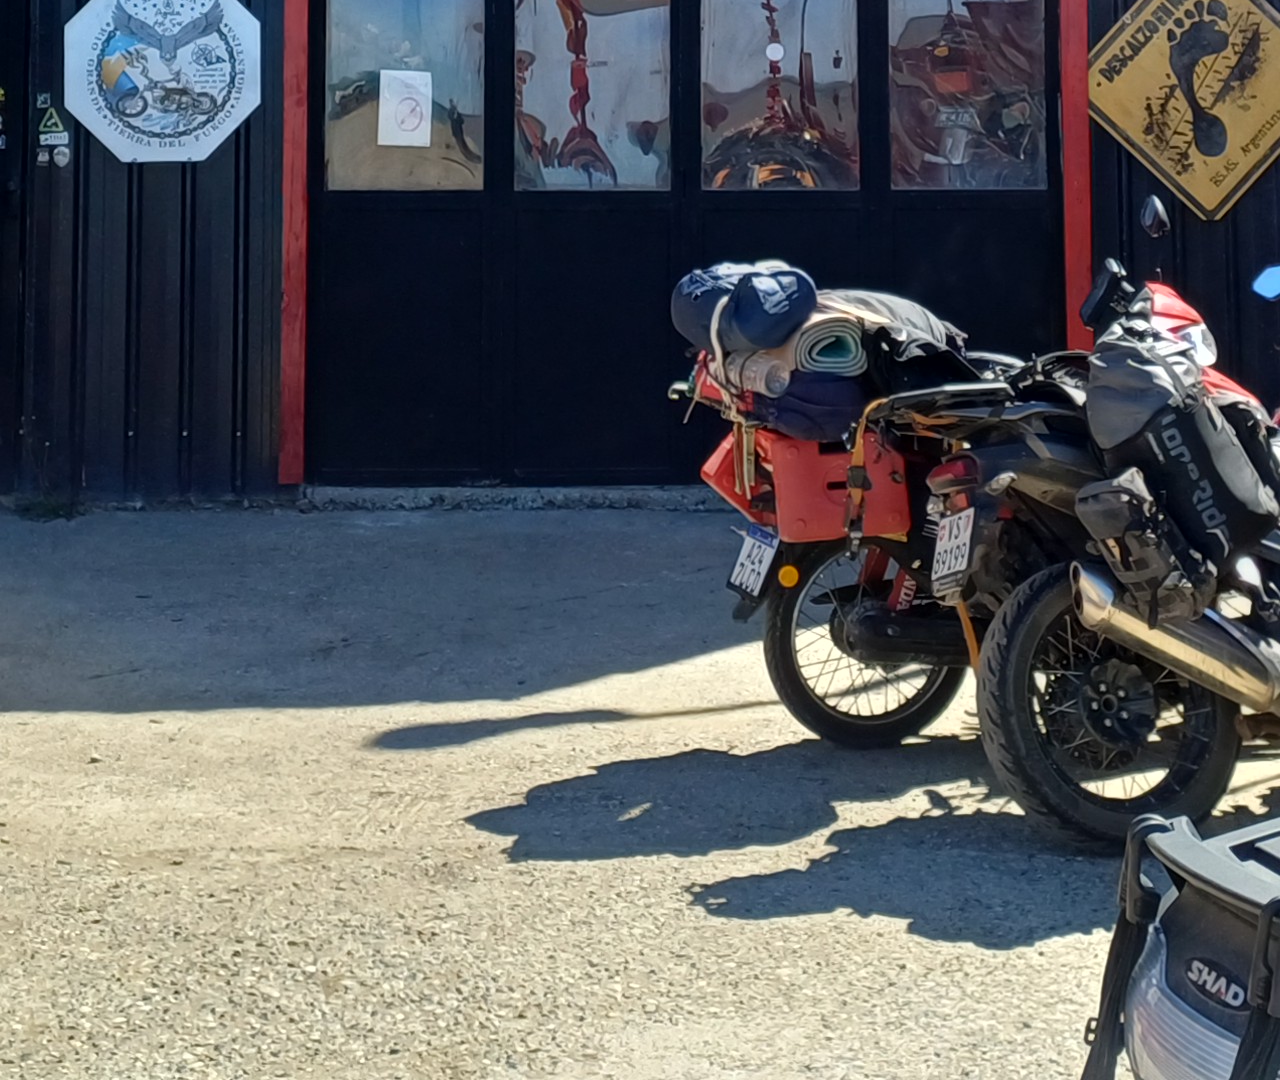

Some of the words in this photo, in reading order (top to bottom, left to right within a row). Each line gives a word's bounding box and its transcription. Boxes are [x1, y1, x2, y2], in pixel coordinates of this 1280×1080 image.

[1098, 19, 1160, 83] DESCALZO
[1150, 0, 1175, 27] EN
[159, 139, 186, 148] DEL
[948, 516, 962, 542] VS
[934, 542, 967, 575] 89199
[896, 574, 917, 611] NDA
[1187, 959, 1245, 1007] SHAD
